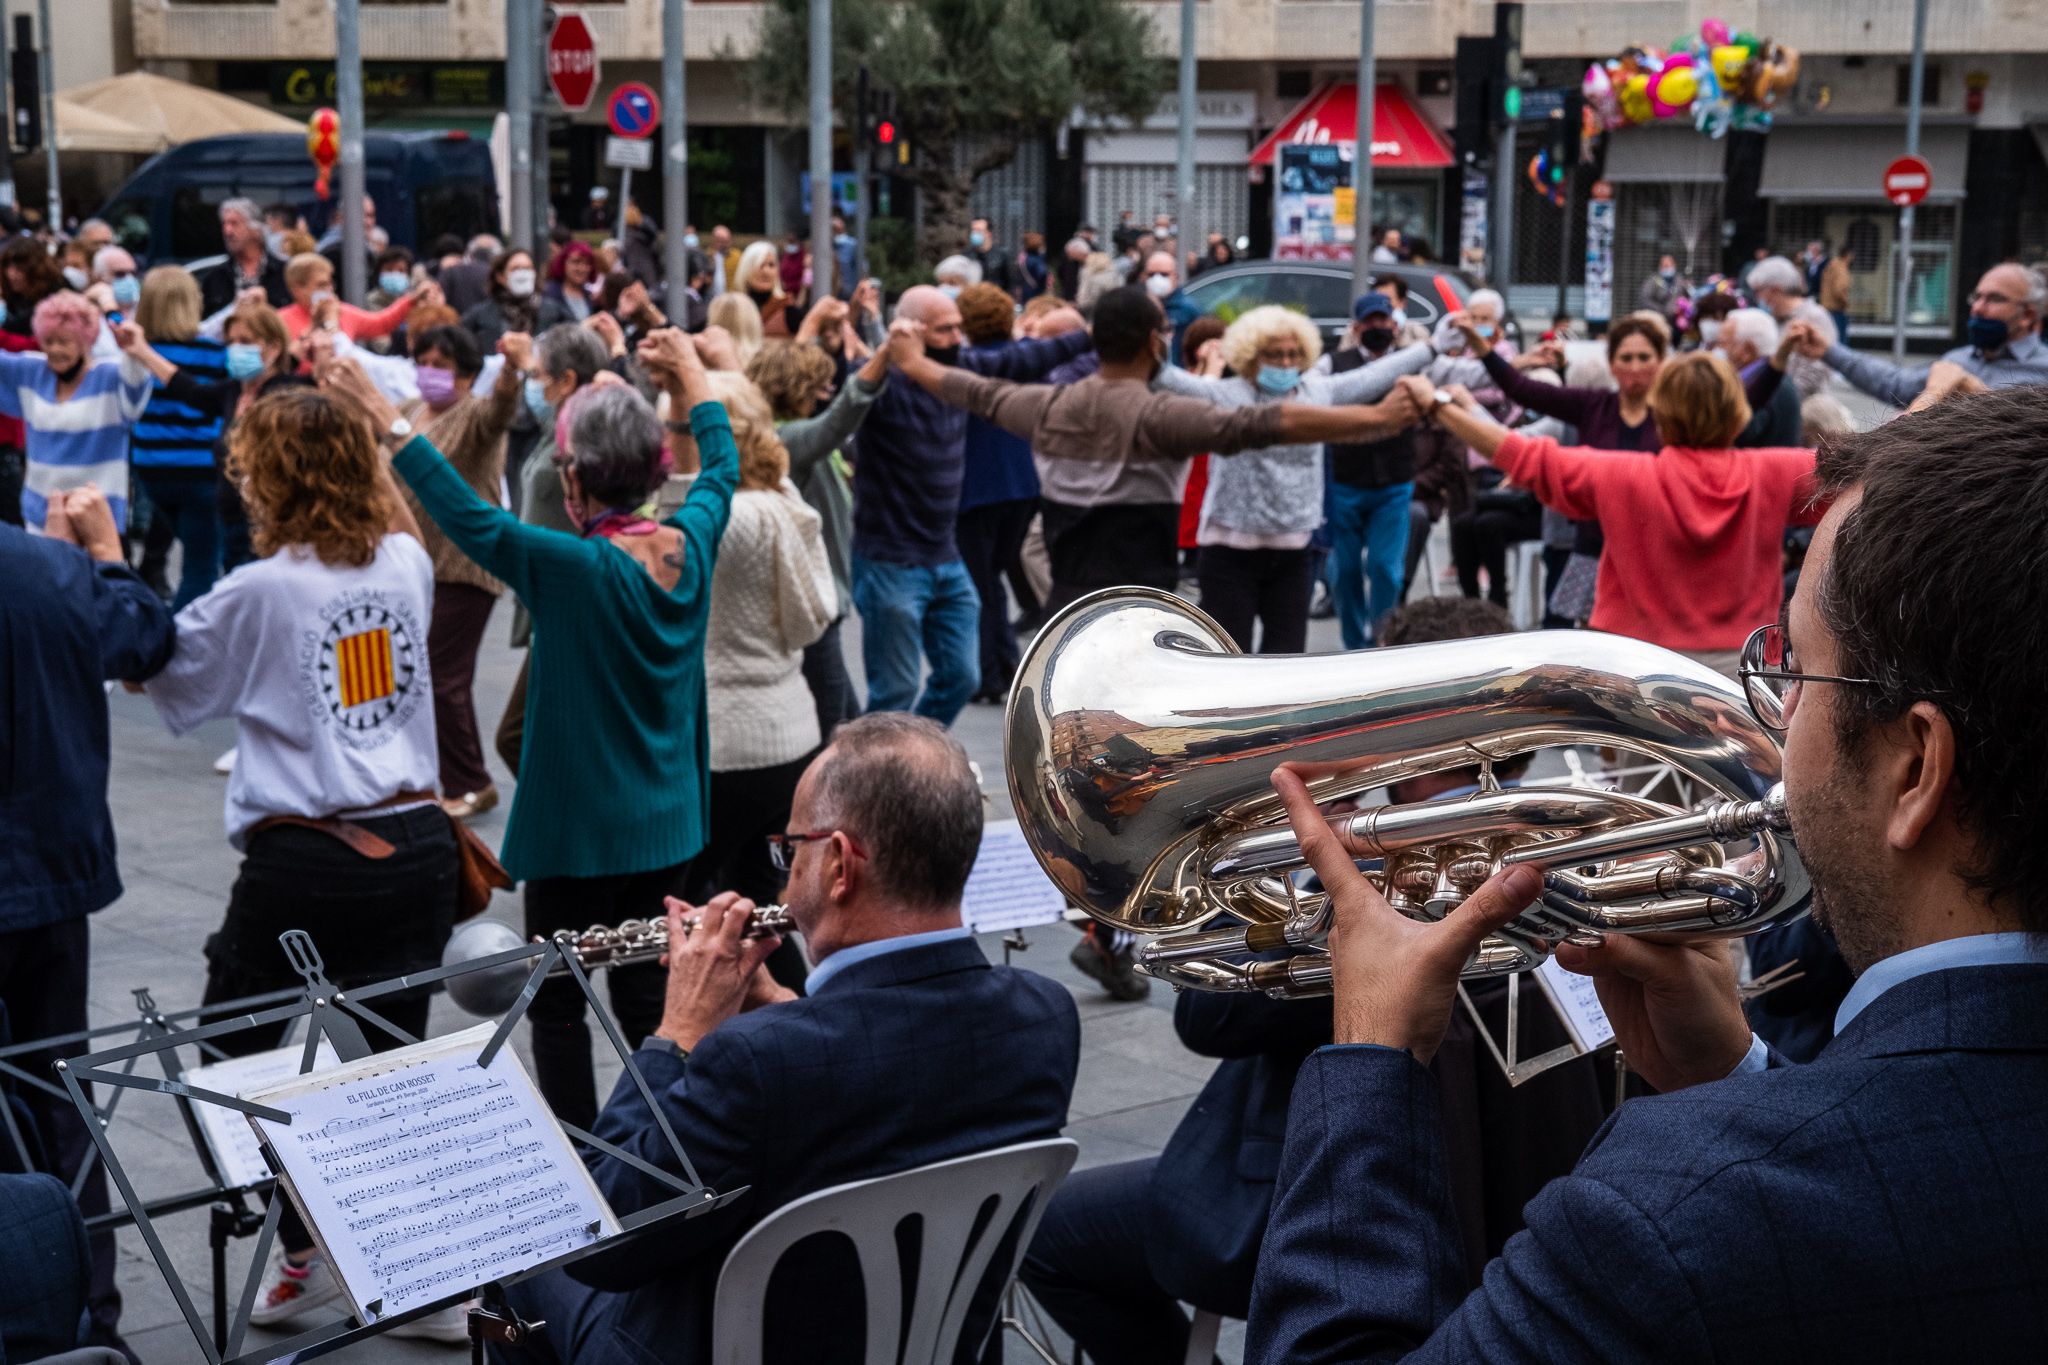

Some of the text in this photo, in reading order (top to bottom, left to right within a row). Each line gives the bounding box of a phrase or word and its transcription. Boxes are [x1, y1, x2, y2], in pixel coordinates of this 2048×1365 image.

[550, 49, 594, 74] STOP
[346, 1073, 436, 1105] EL FILL DE CAN ROSSET
